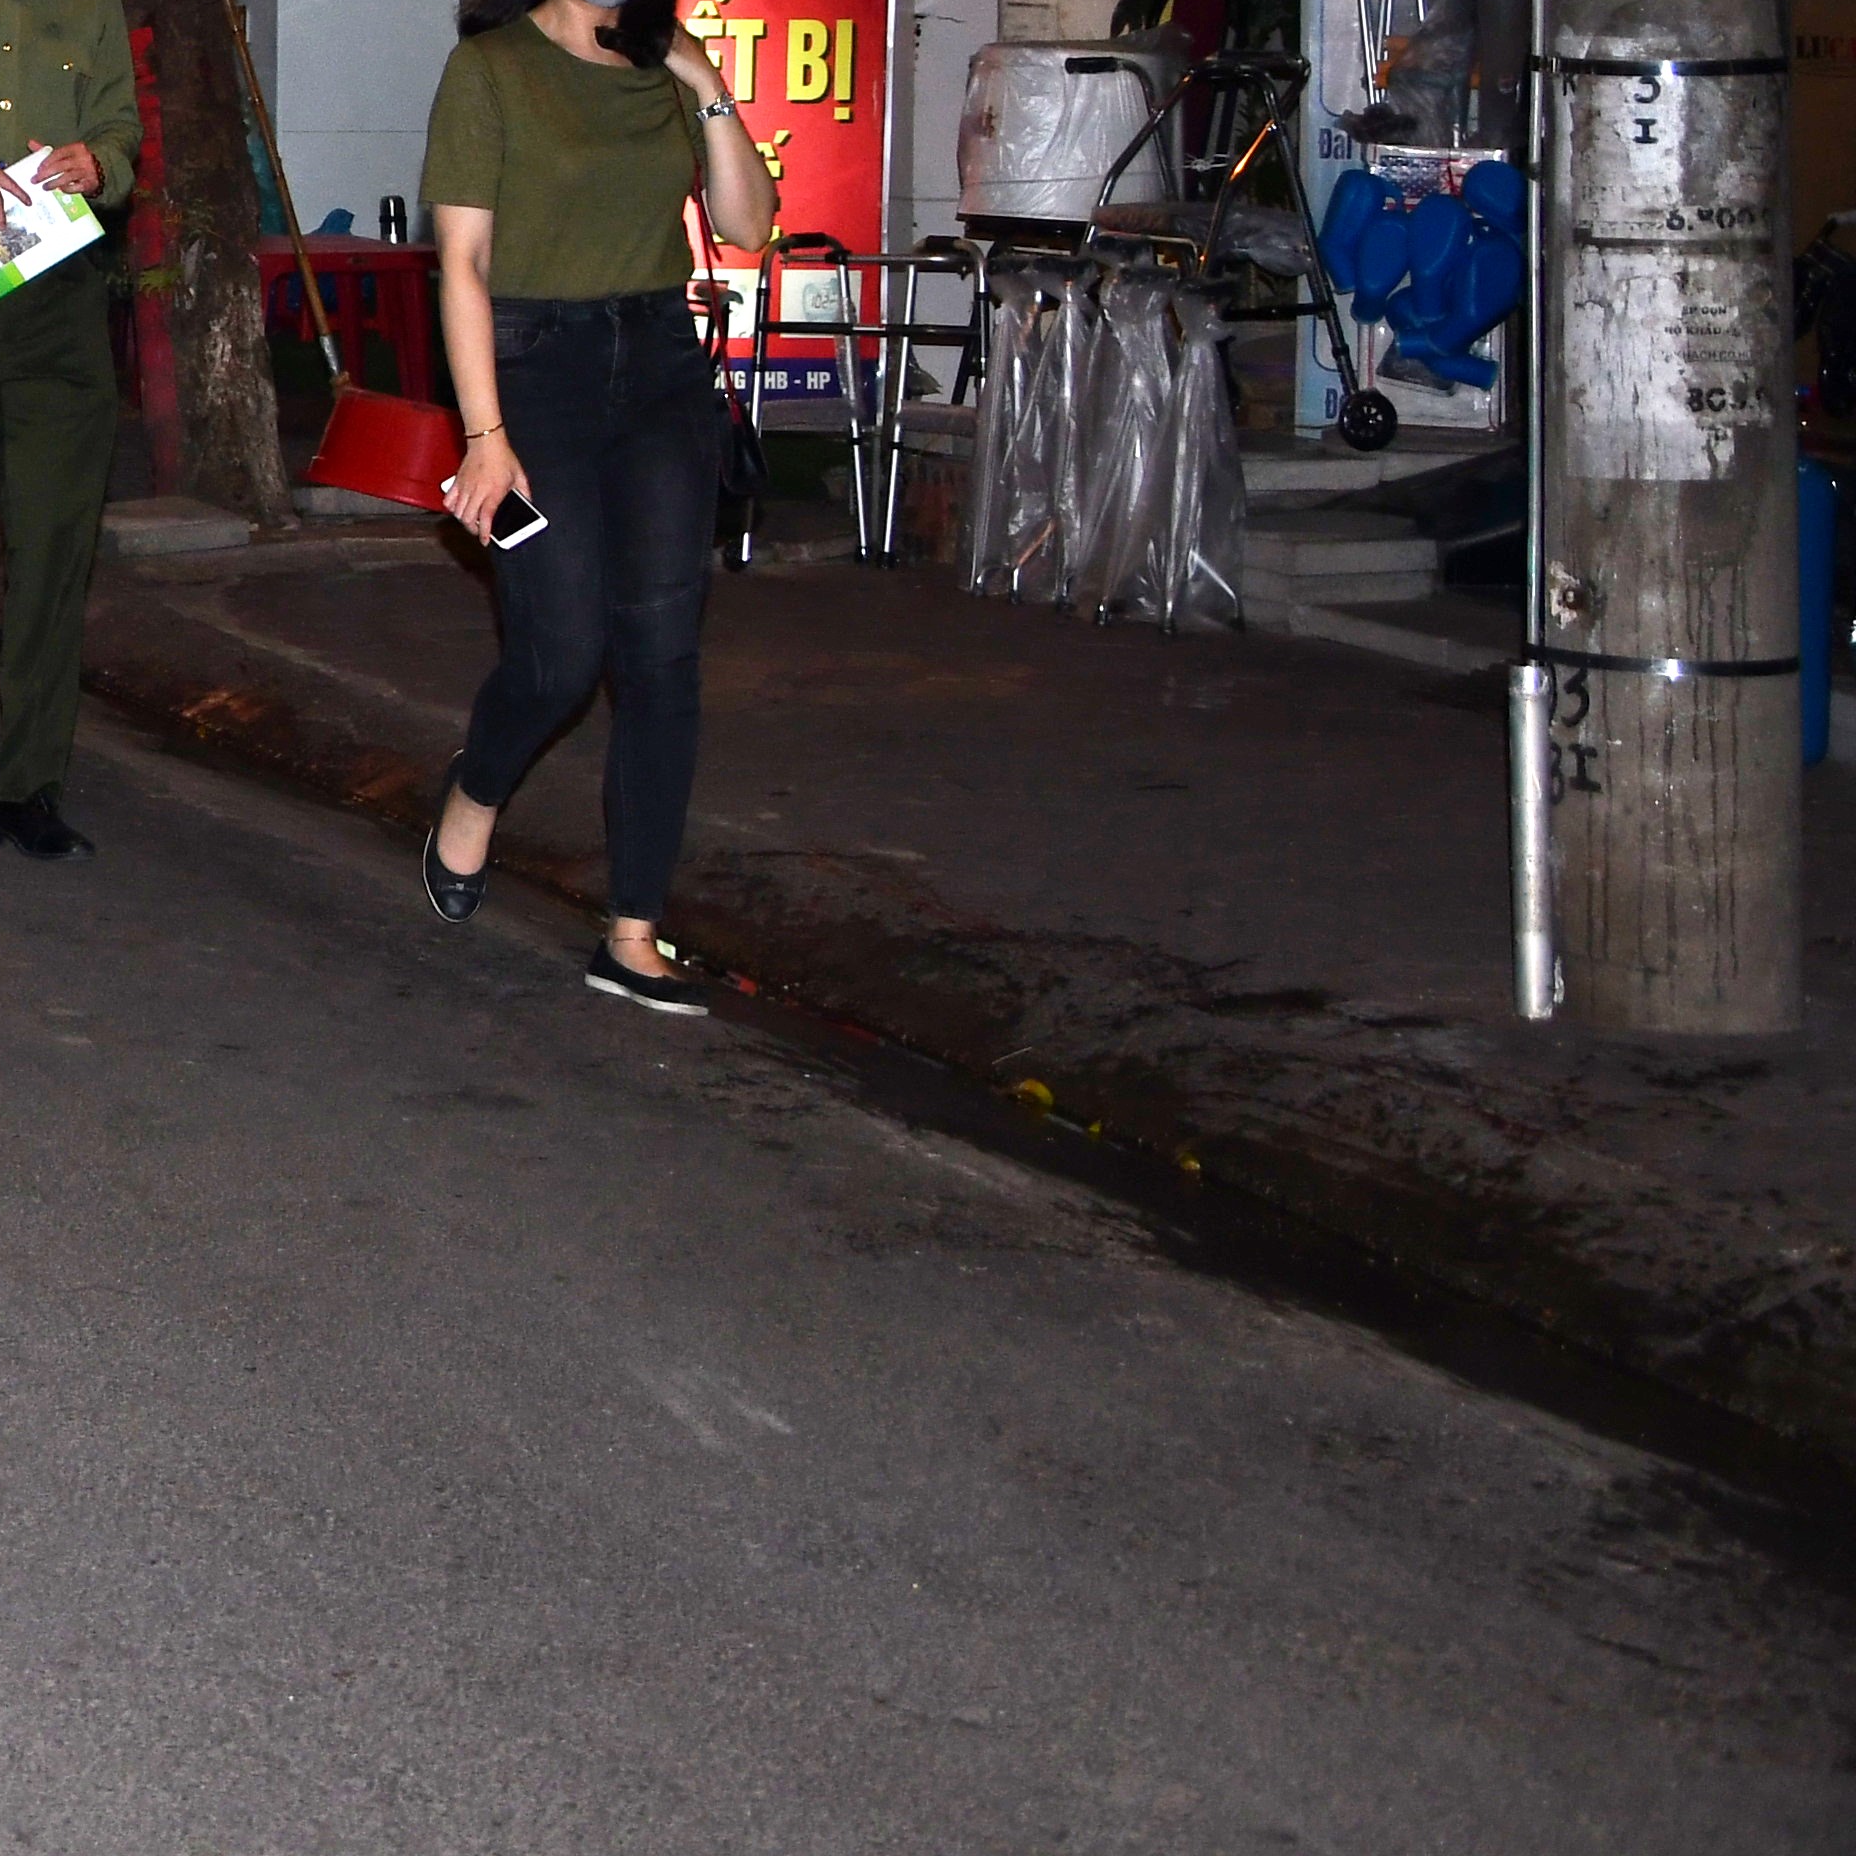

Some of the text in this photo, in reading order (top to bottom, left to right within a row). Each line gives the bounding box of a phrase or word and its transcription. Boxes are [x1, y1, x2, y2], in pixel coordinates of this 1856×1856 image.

[785, 19, 856, 124] BỊ
[764, 370, 788, 390] HB
[806, 370, 831, 391] HP
